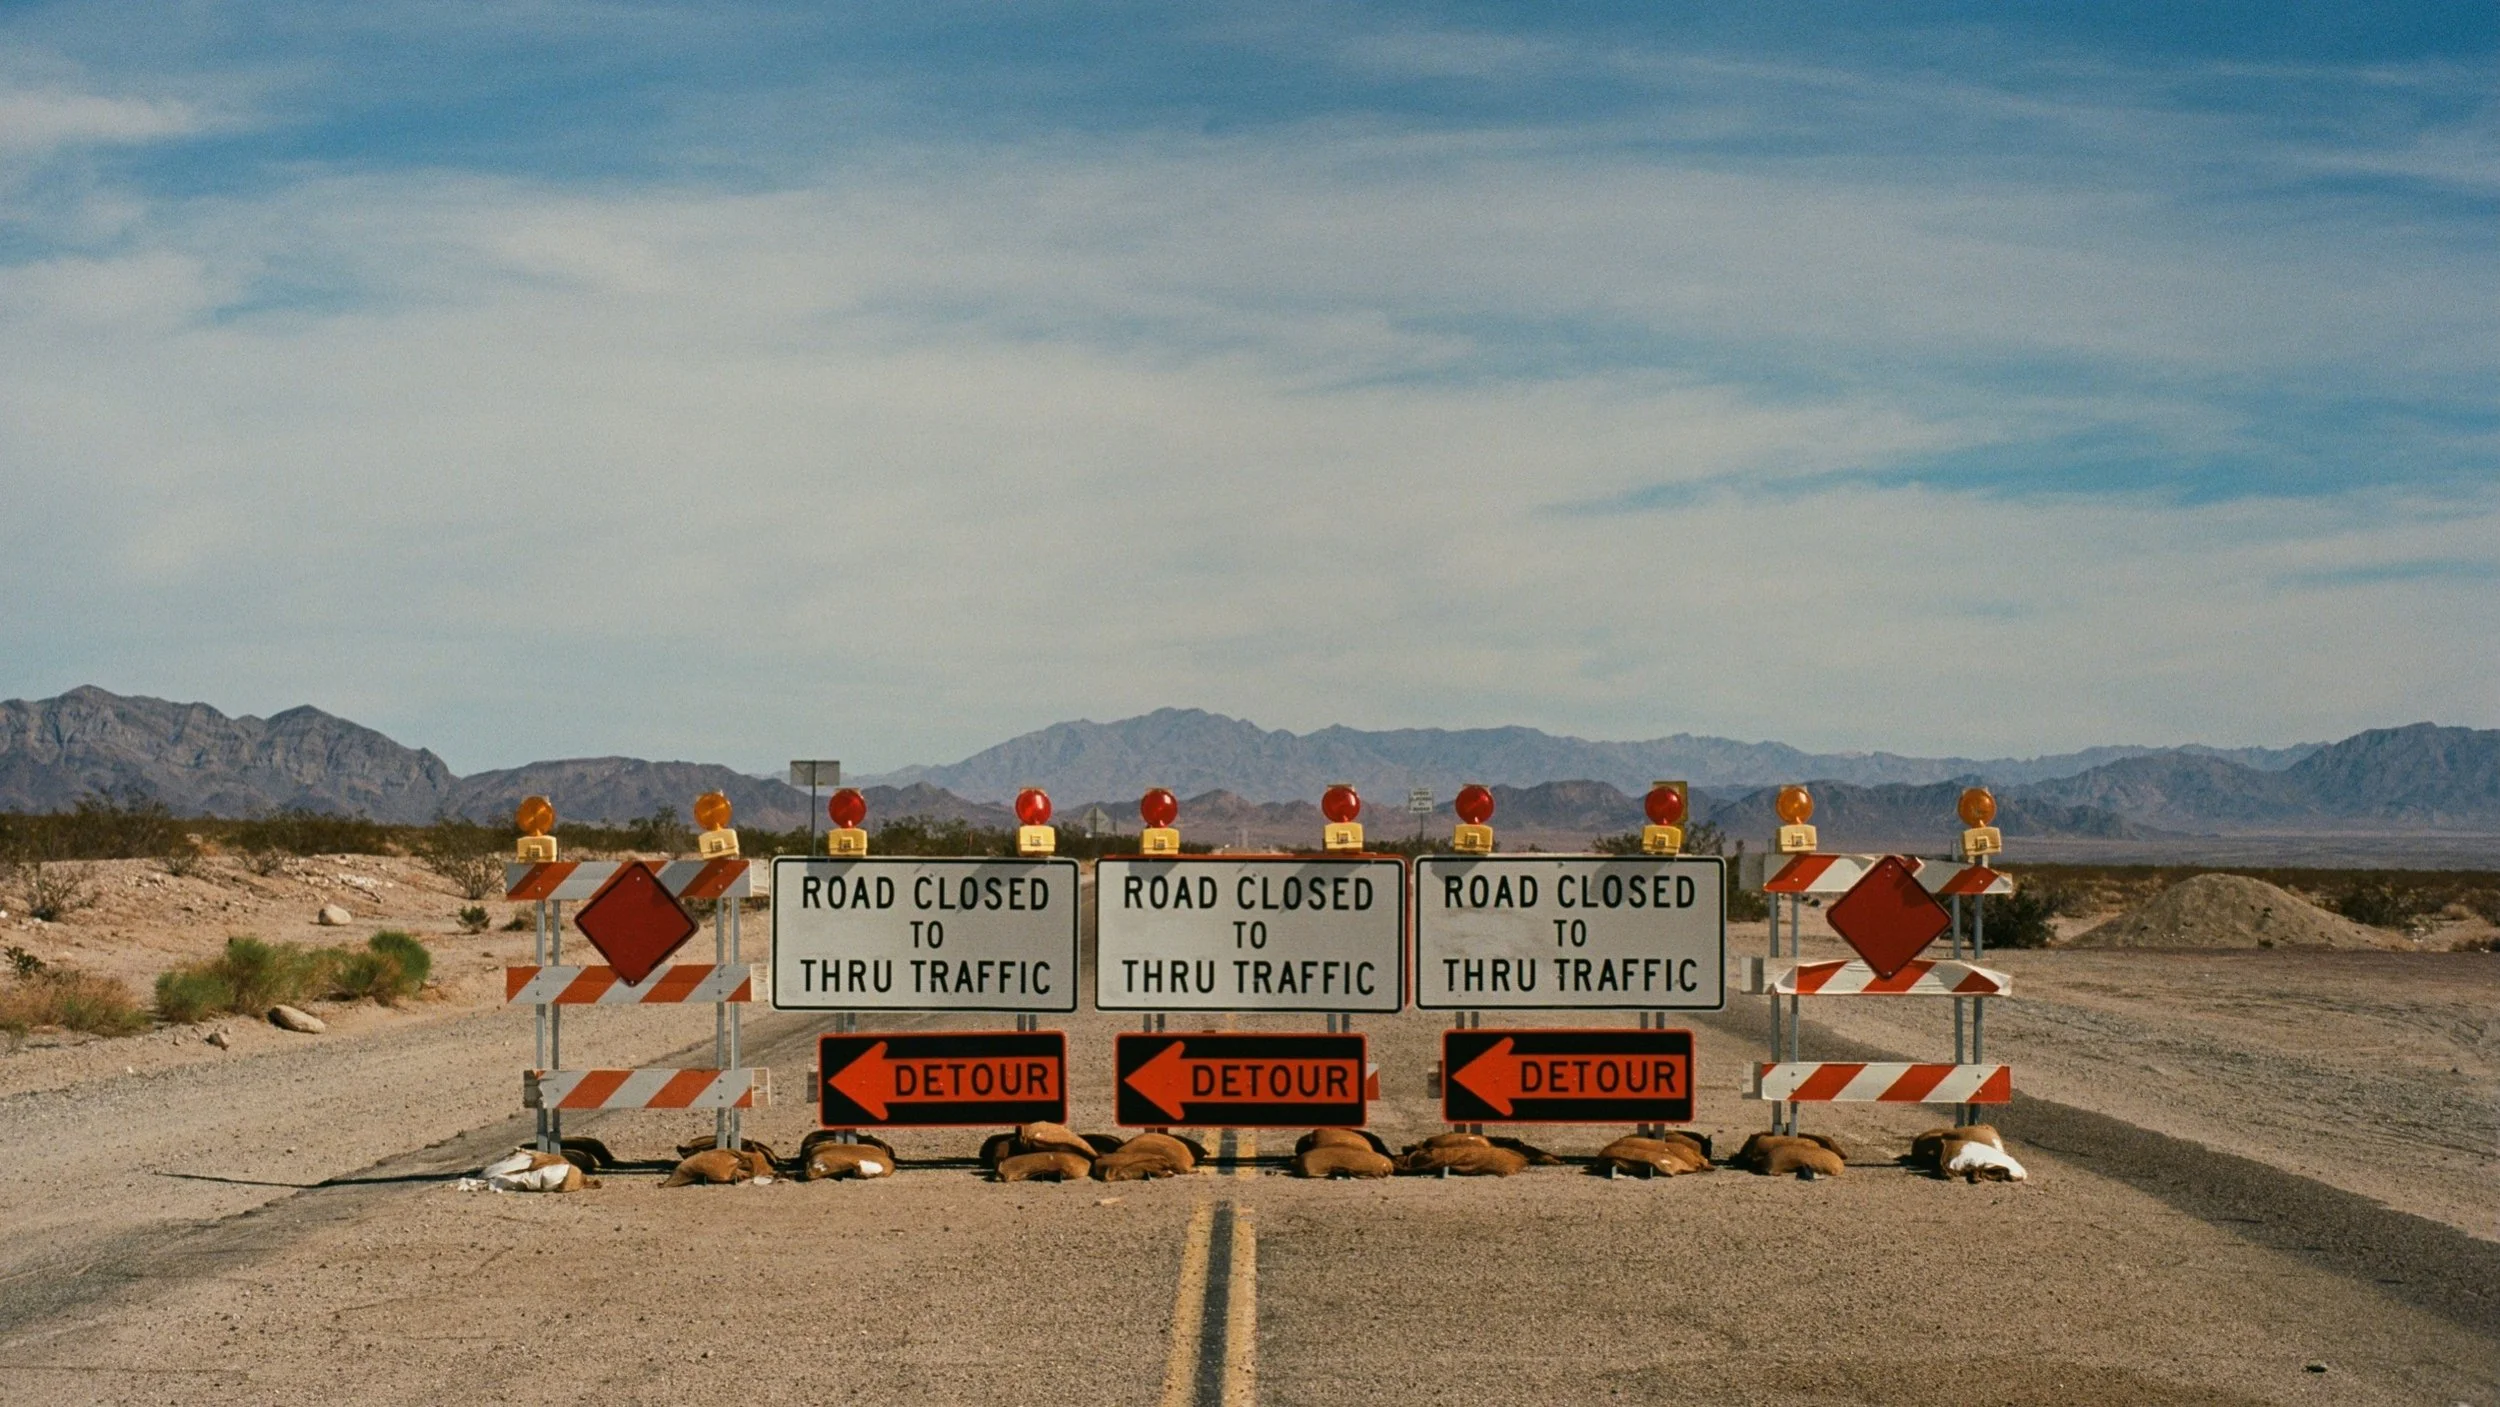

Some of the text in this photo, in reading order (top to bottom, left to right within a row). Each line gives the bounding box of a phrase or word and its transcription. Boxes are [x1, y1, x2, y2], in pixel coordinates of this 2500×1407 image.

[802, 875, 1049, 911] ROAD CLOSED
[1124, 874, 1374, 911] ROAD CLOSED
[1443, 873, 1695, 909] ROAD CLOSED
[909, 920, 944, 950] TO
[1232, 920, 1267, 950] TO
[1553, 918, 1587, 948] TO
[800, 959, 1051, 995] THRU TRAFFIC
[1121, 959, 1376, 996] THRU TRAFFIC
[1442, 958, 1698, 993] THRU TRAFFIC
[895, 1063, 1050, 1097] DETOUR
[1192, 1064, 1350, 1098] DETOUR
[1520, 1060, 1677, 1093] DETOUR
